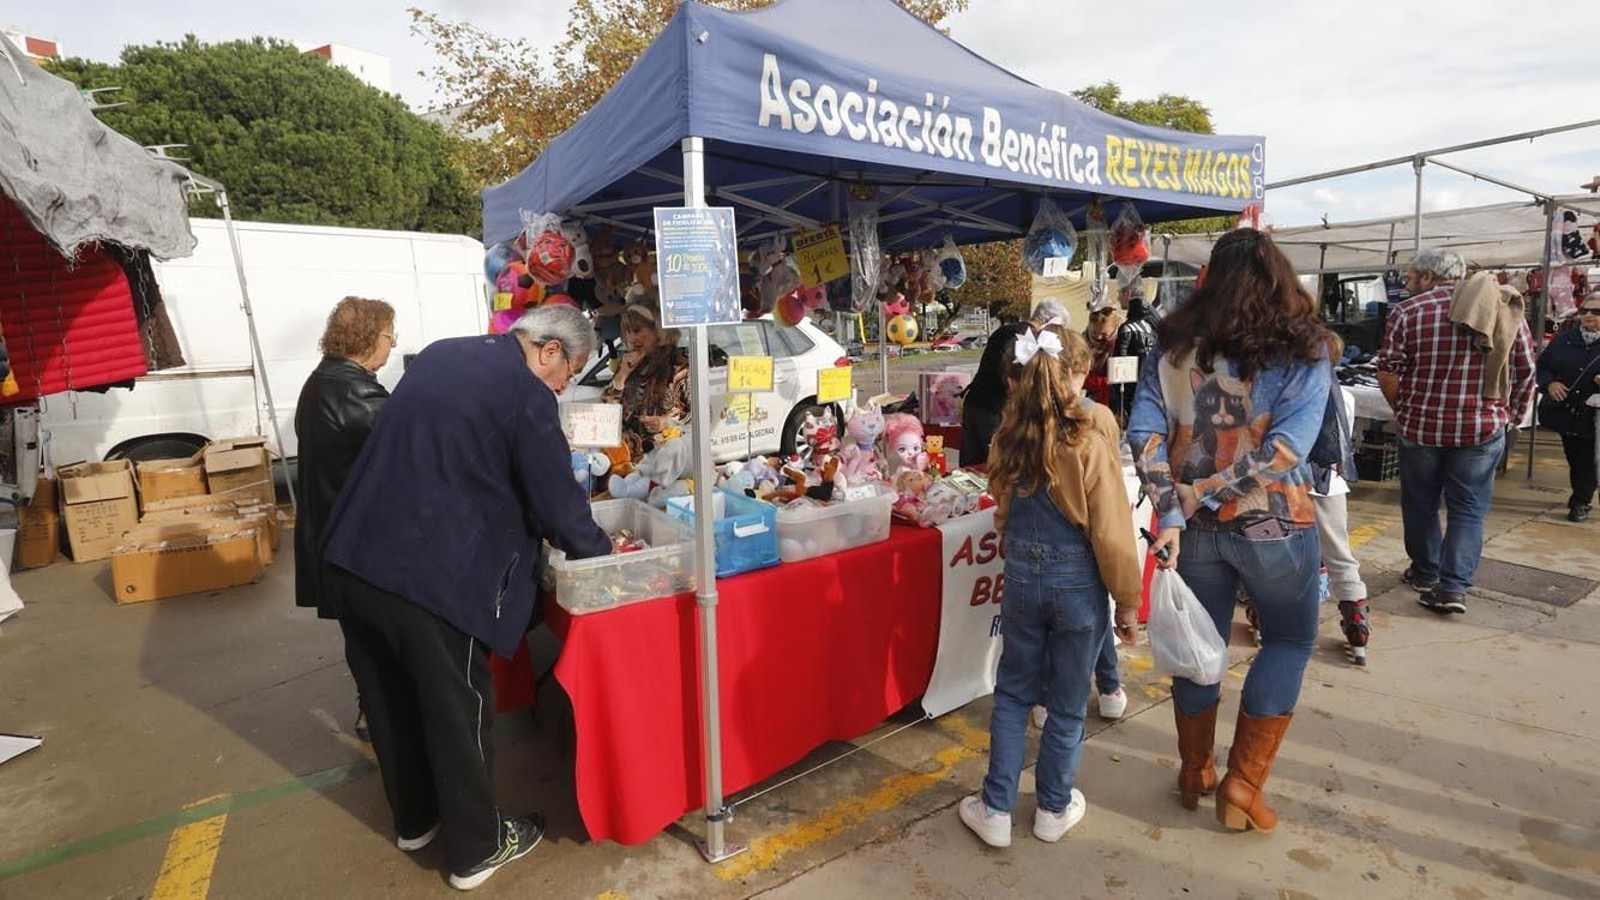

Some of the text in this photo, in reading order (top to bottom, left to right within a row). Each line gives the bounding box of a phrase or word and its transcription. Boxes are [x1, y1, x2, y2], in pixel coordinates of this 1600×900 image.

[758, 53, 1102, 186] Asociación Benéfica
[1105, 133, 1251, 199] REYES MAGOS
[665, 253, 682, 273] 10
[989, 614, 1003, 638] R
